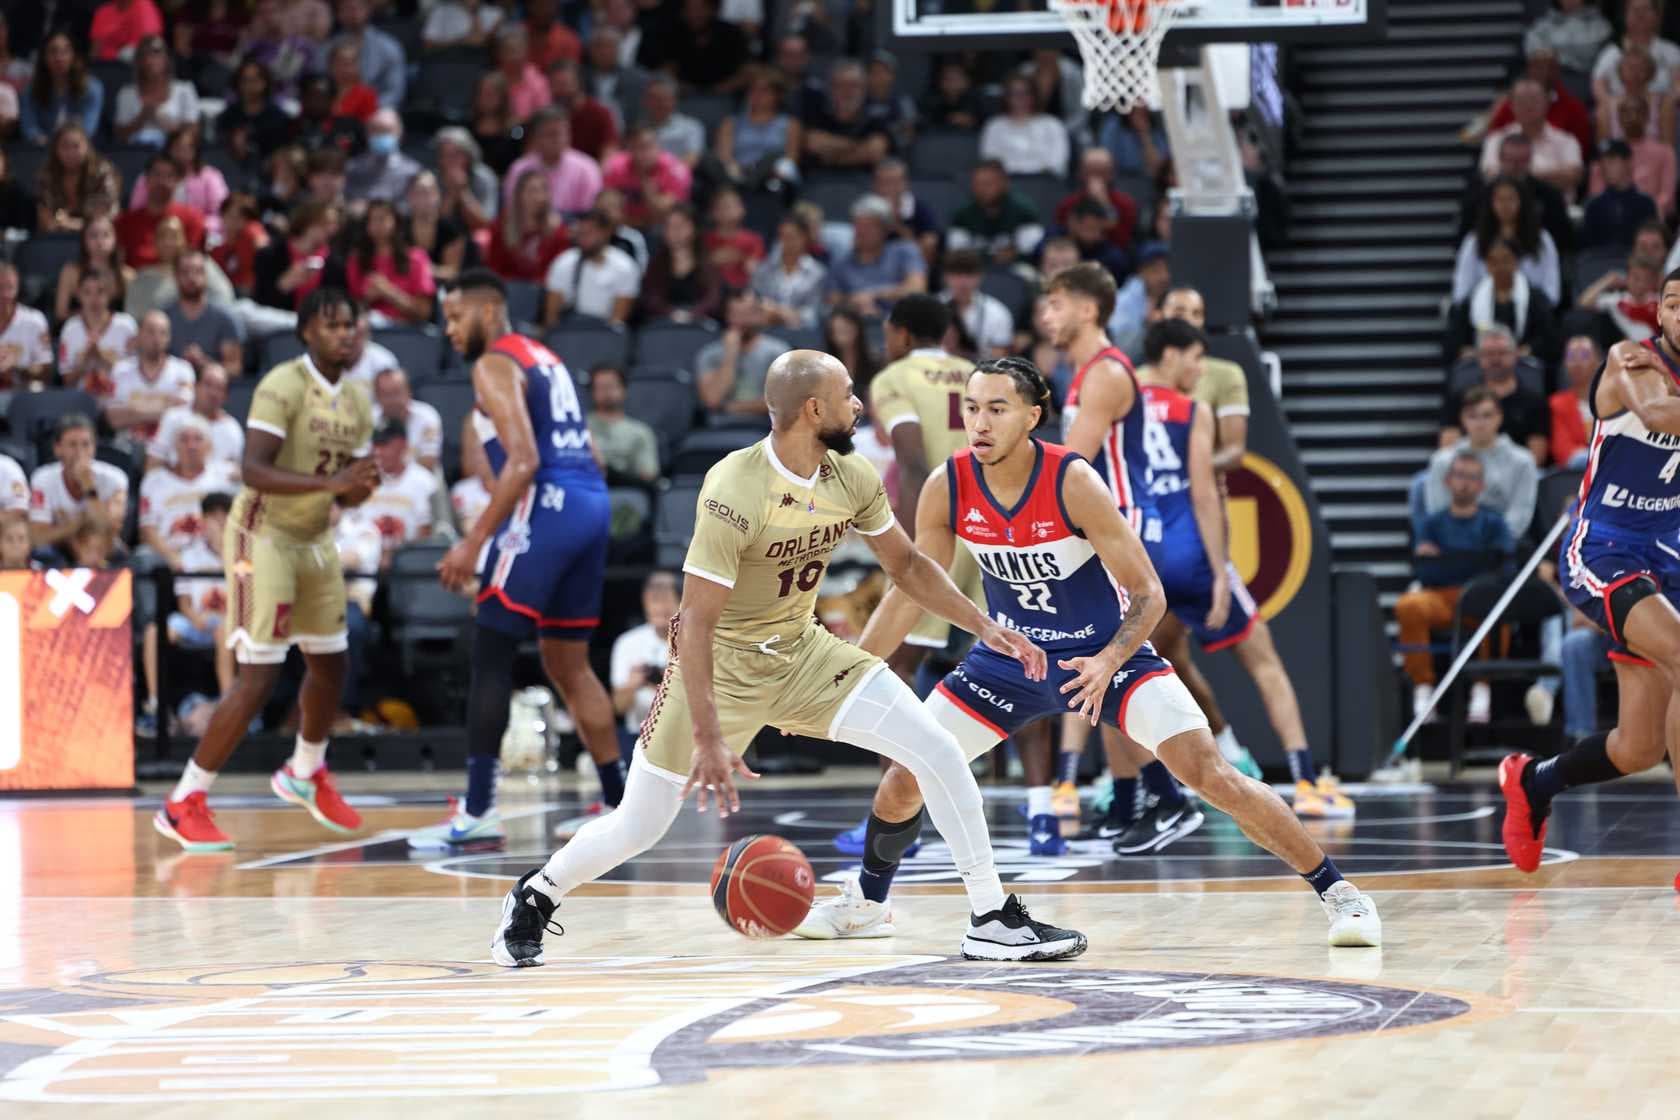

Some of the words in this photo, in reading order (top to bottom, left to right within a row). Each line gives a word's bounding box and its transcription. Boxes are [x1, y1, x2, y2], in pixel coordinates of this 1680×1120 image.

[778, 560, 824, 598] 10
[978, 550, 1061, 581] NANTES
[1010, 582, 1058, 614] 22
